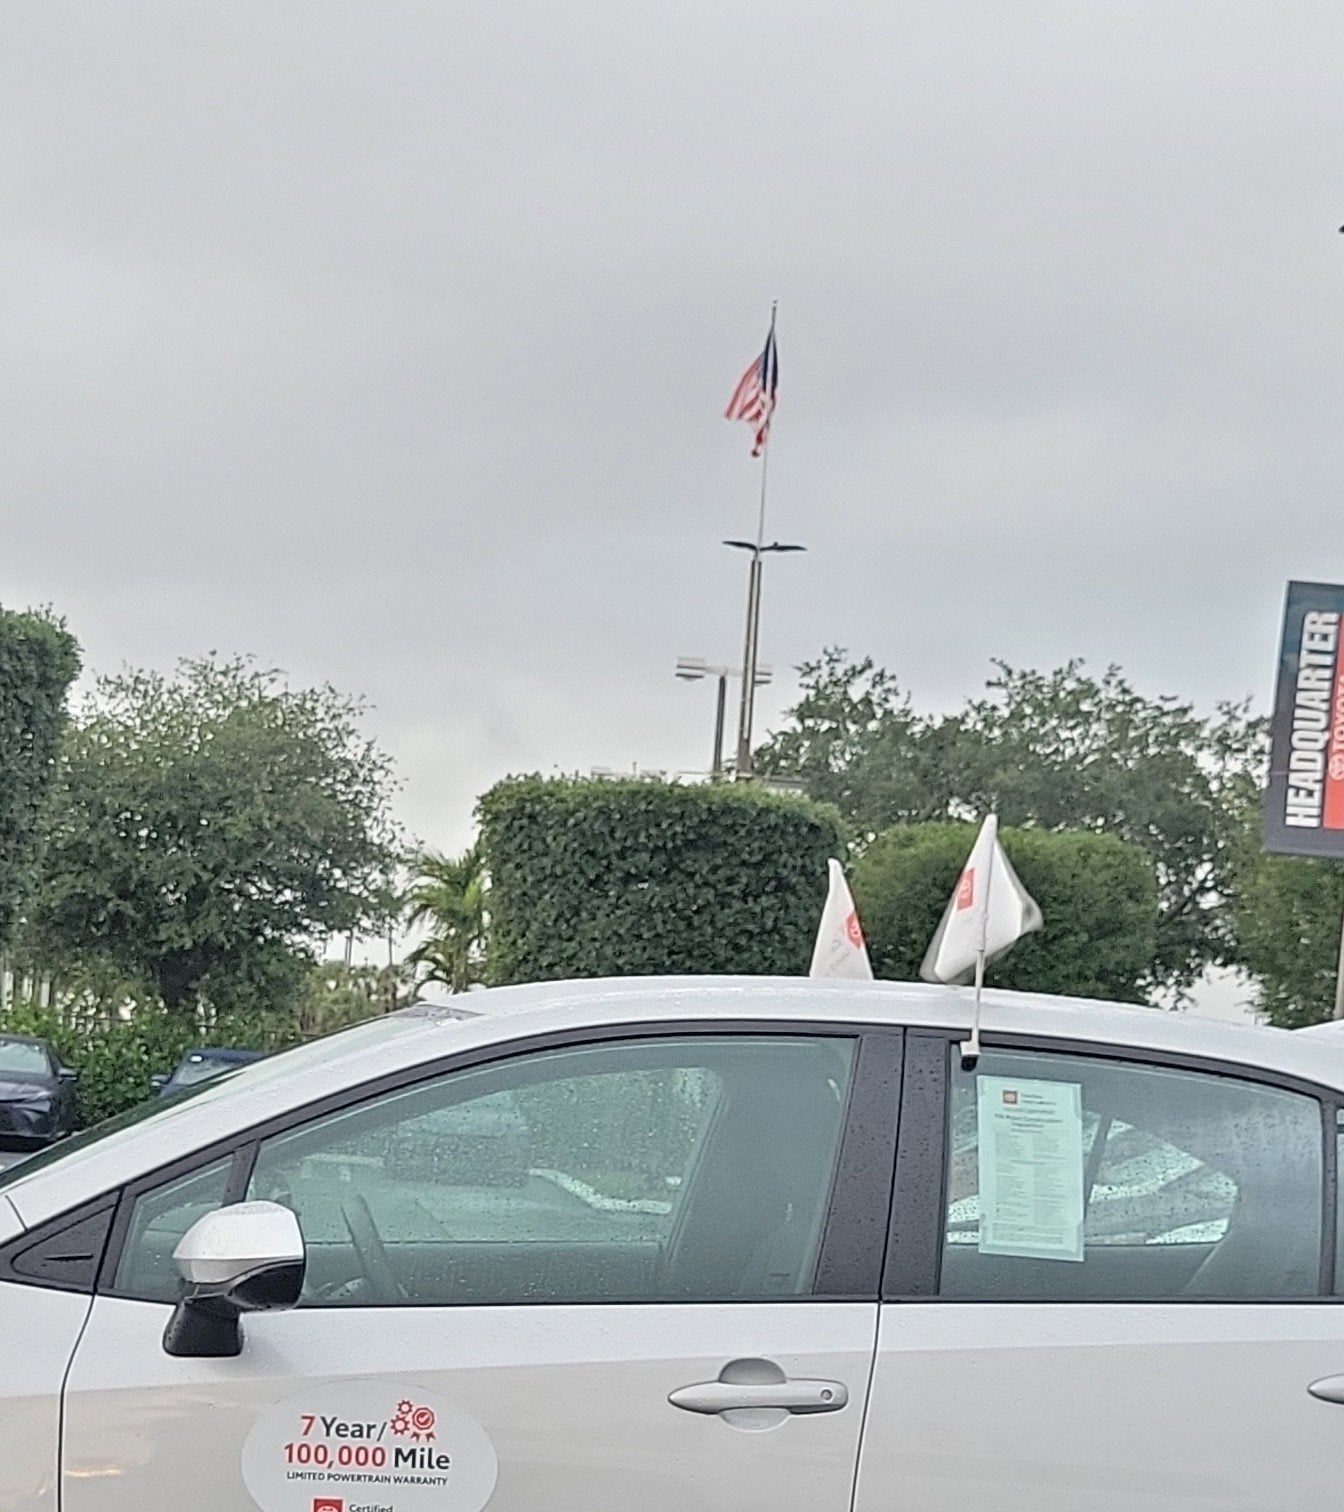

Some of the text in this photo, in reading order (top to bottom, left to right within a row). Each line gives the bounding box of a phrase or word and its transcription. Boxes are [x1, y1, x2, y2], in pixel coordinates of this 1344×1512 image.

[1285, 611, 1339, 827] HEADQUARTER
[301, 1416, 387, 1442] 7 Year/
[284, 1443, 450, 1470] 100,000 Mile
[287, 1472, 447, 1486] LIMITED POWERTRAIN WARRANTY
